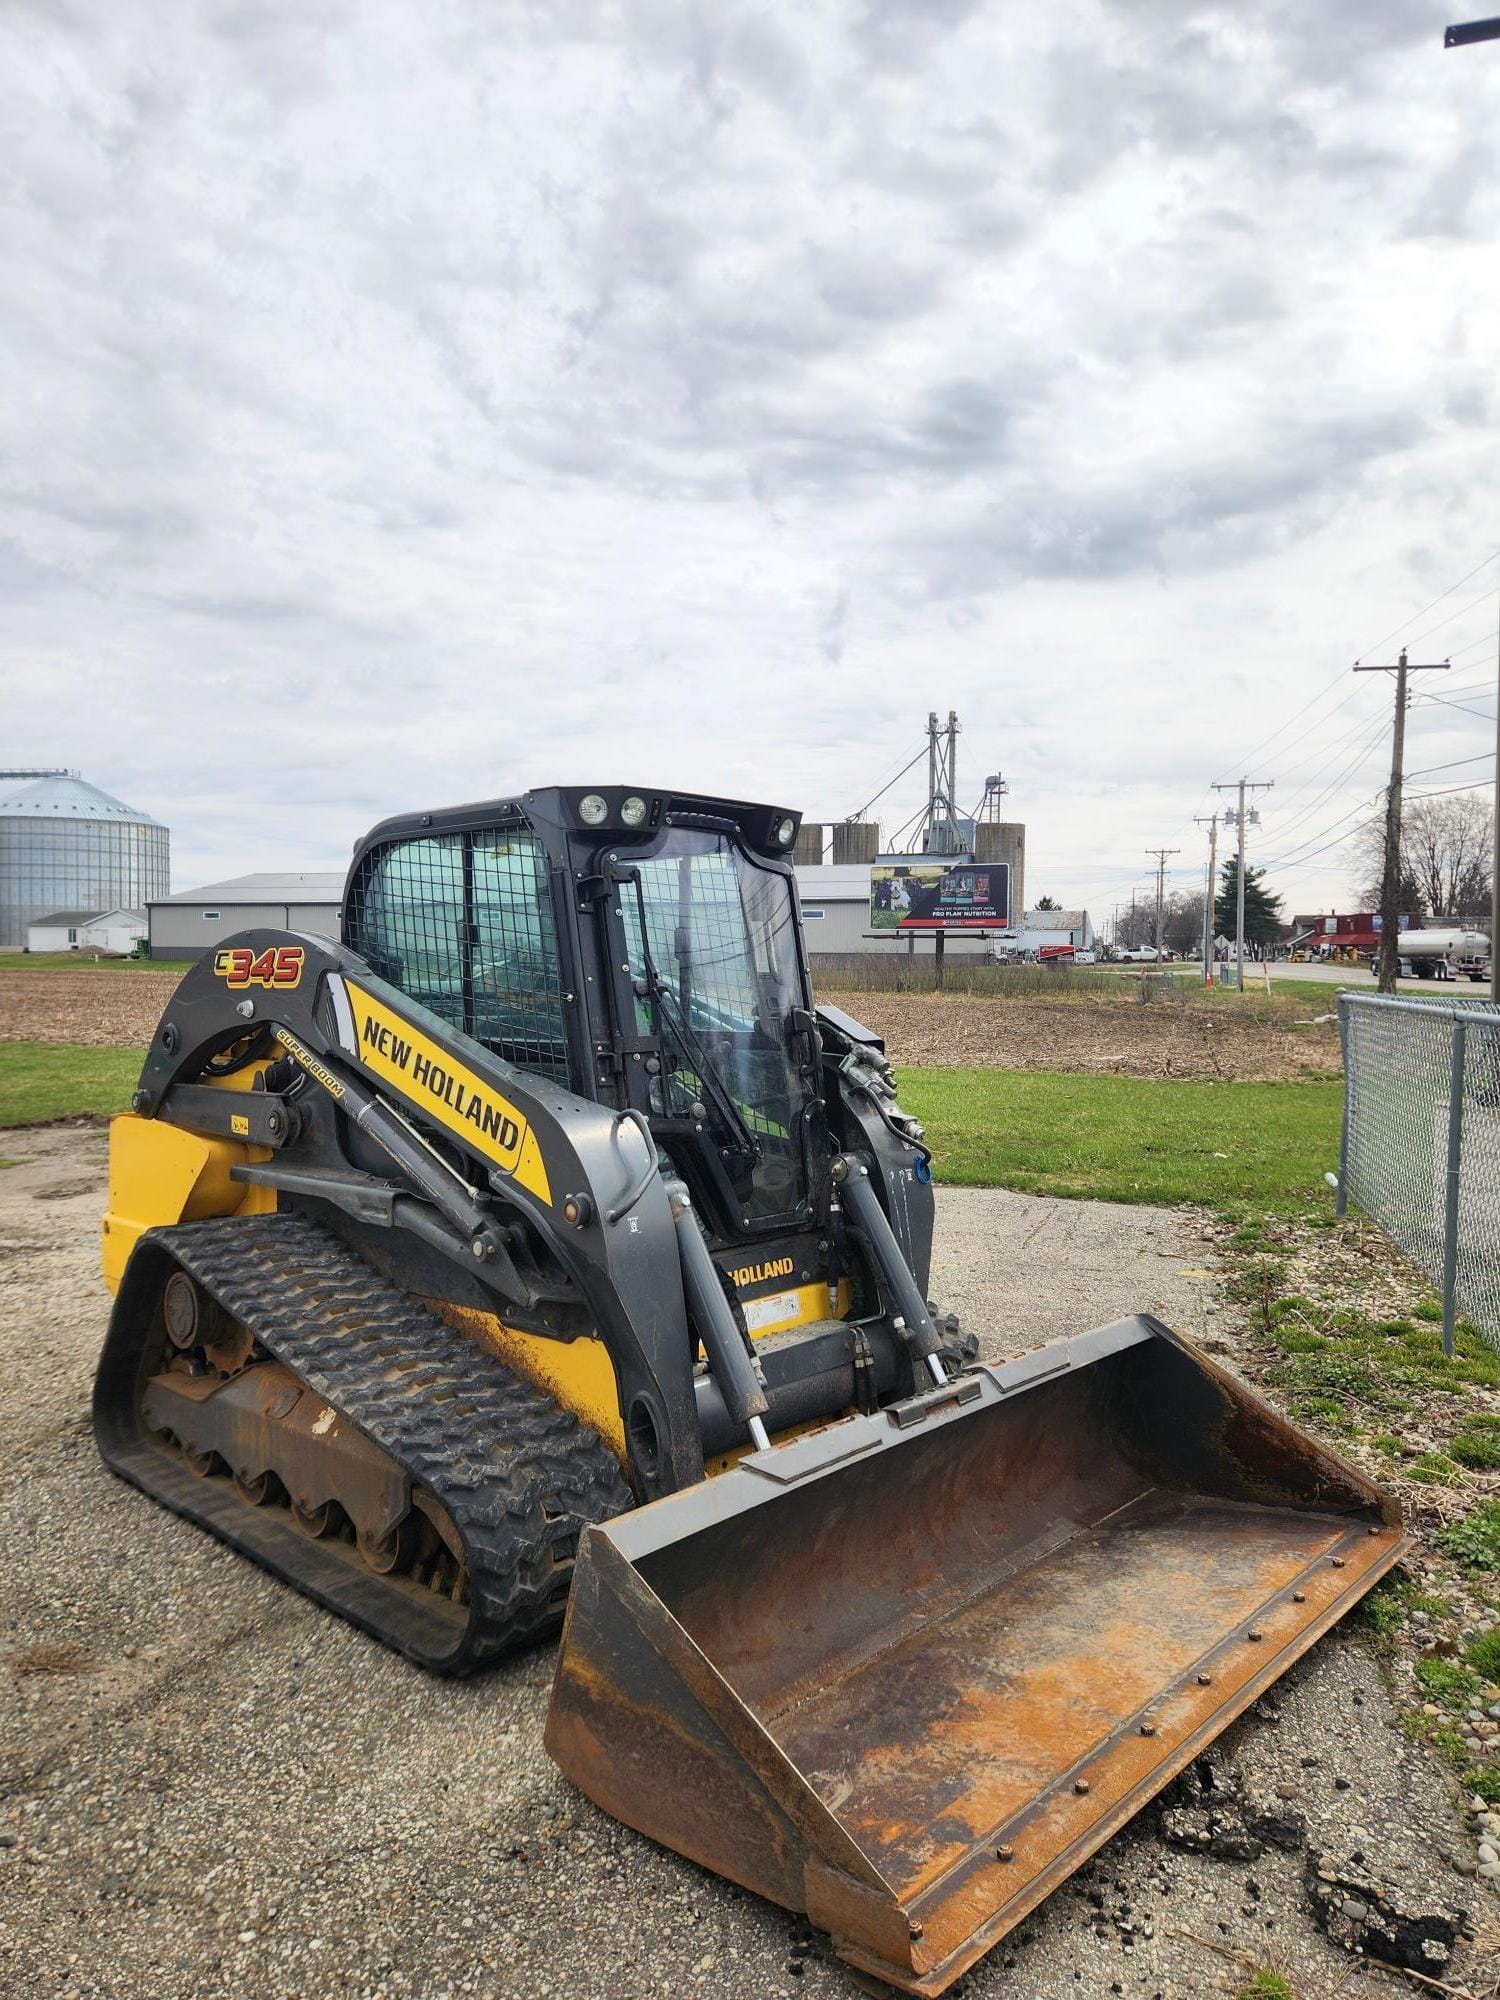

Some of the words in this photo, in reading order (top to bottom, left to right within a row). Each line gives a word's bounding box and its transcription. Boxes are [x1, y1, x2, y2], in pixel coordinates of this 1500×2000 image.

[214, 947, 304, 988] C345
[363, 1016, 412, 1070] NEW
[412, 1053, 519, 1152] HOLLAND
